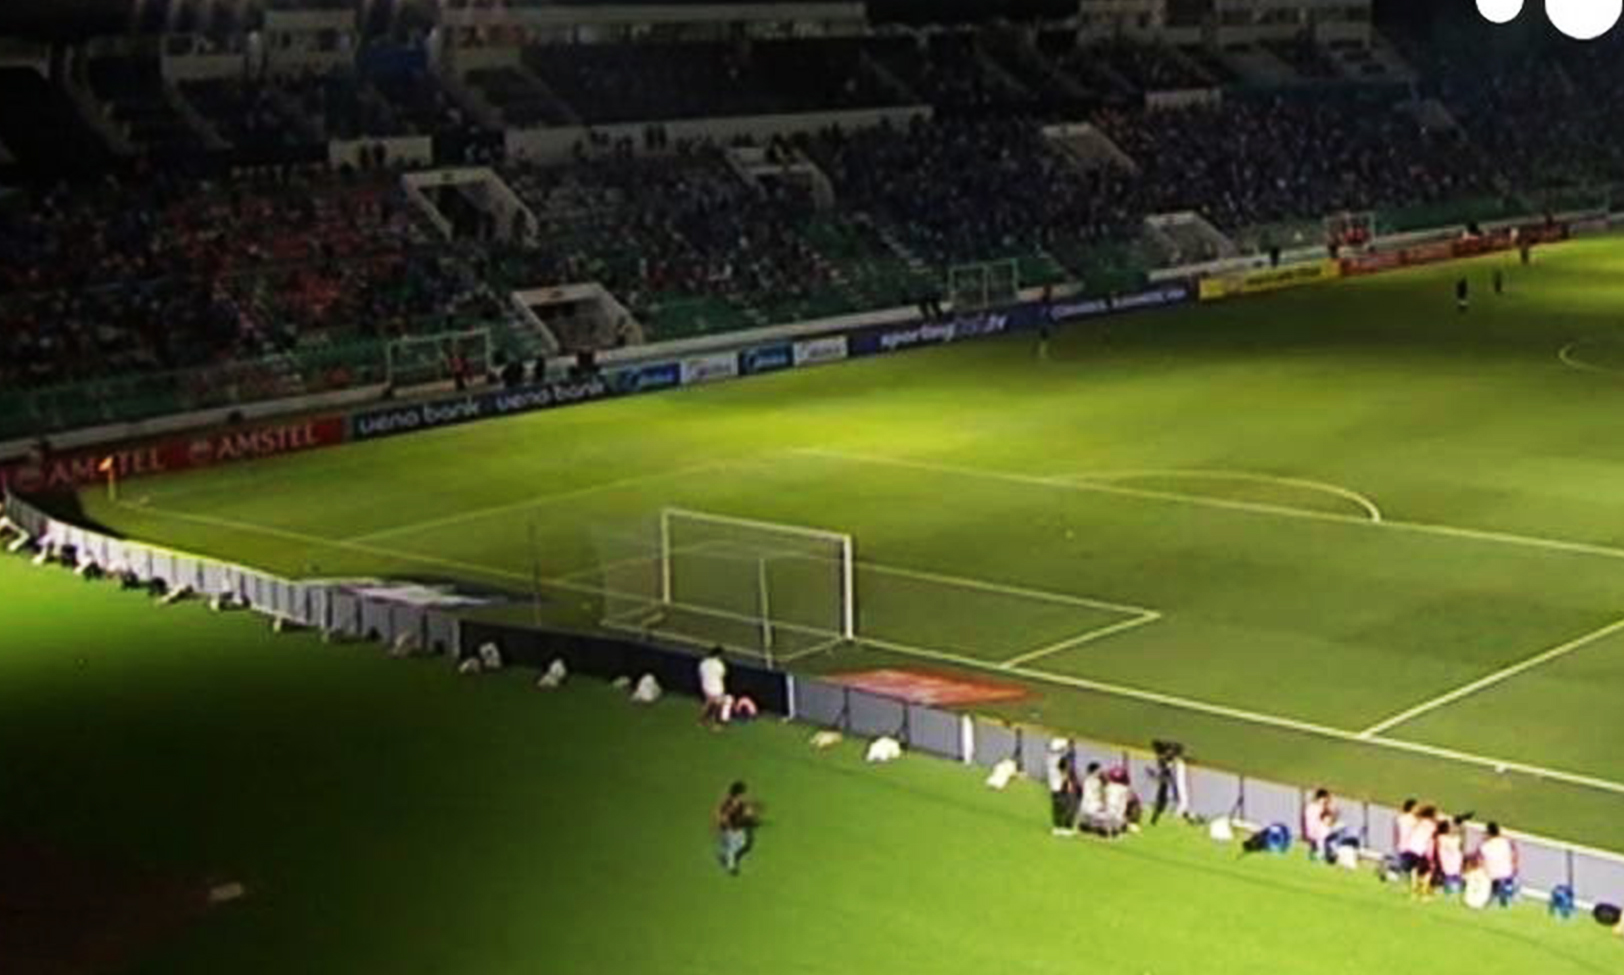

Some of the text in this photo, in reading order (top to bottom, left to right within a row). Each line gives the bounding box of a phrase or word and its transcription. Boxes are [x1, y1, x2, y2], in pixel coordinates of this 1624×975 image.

[359, 409, 419, 433] ueno
[423, 396, 481, 421] bank
[495, 387, 550, 411] ueno
[49, 424, 319, 485] AMTEL AMSTEL
